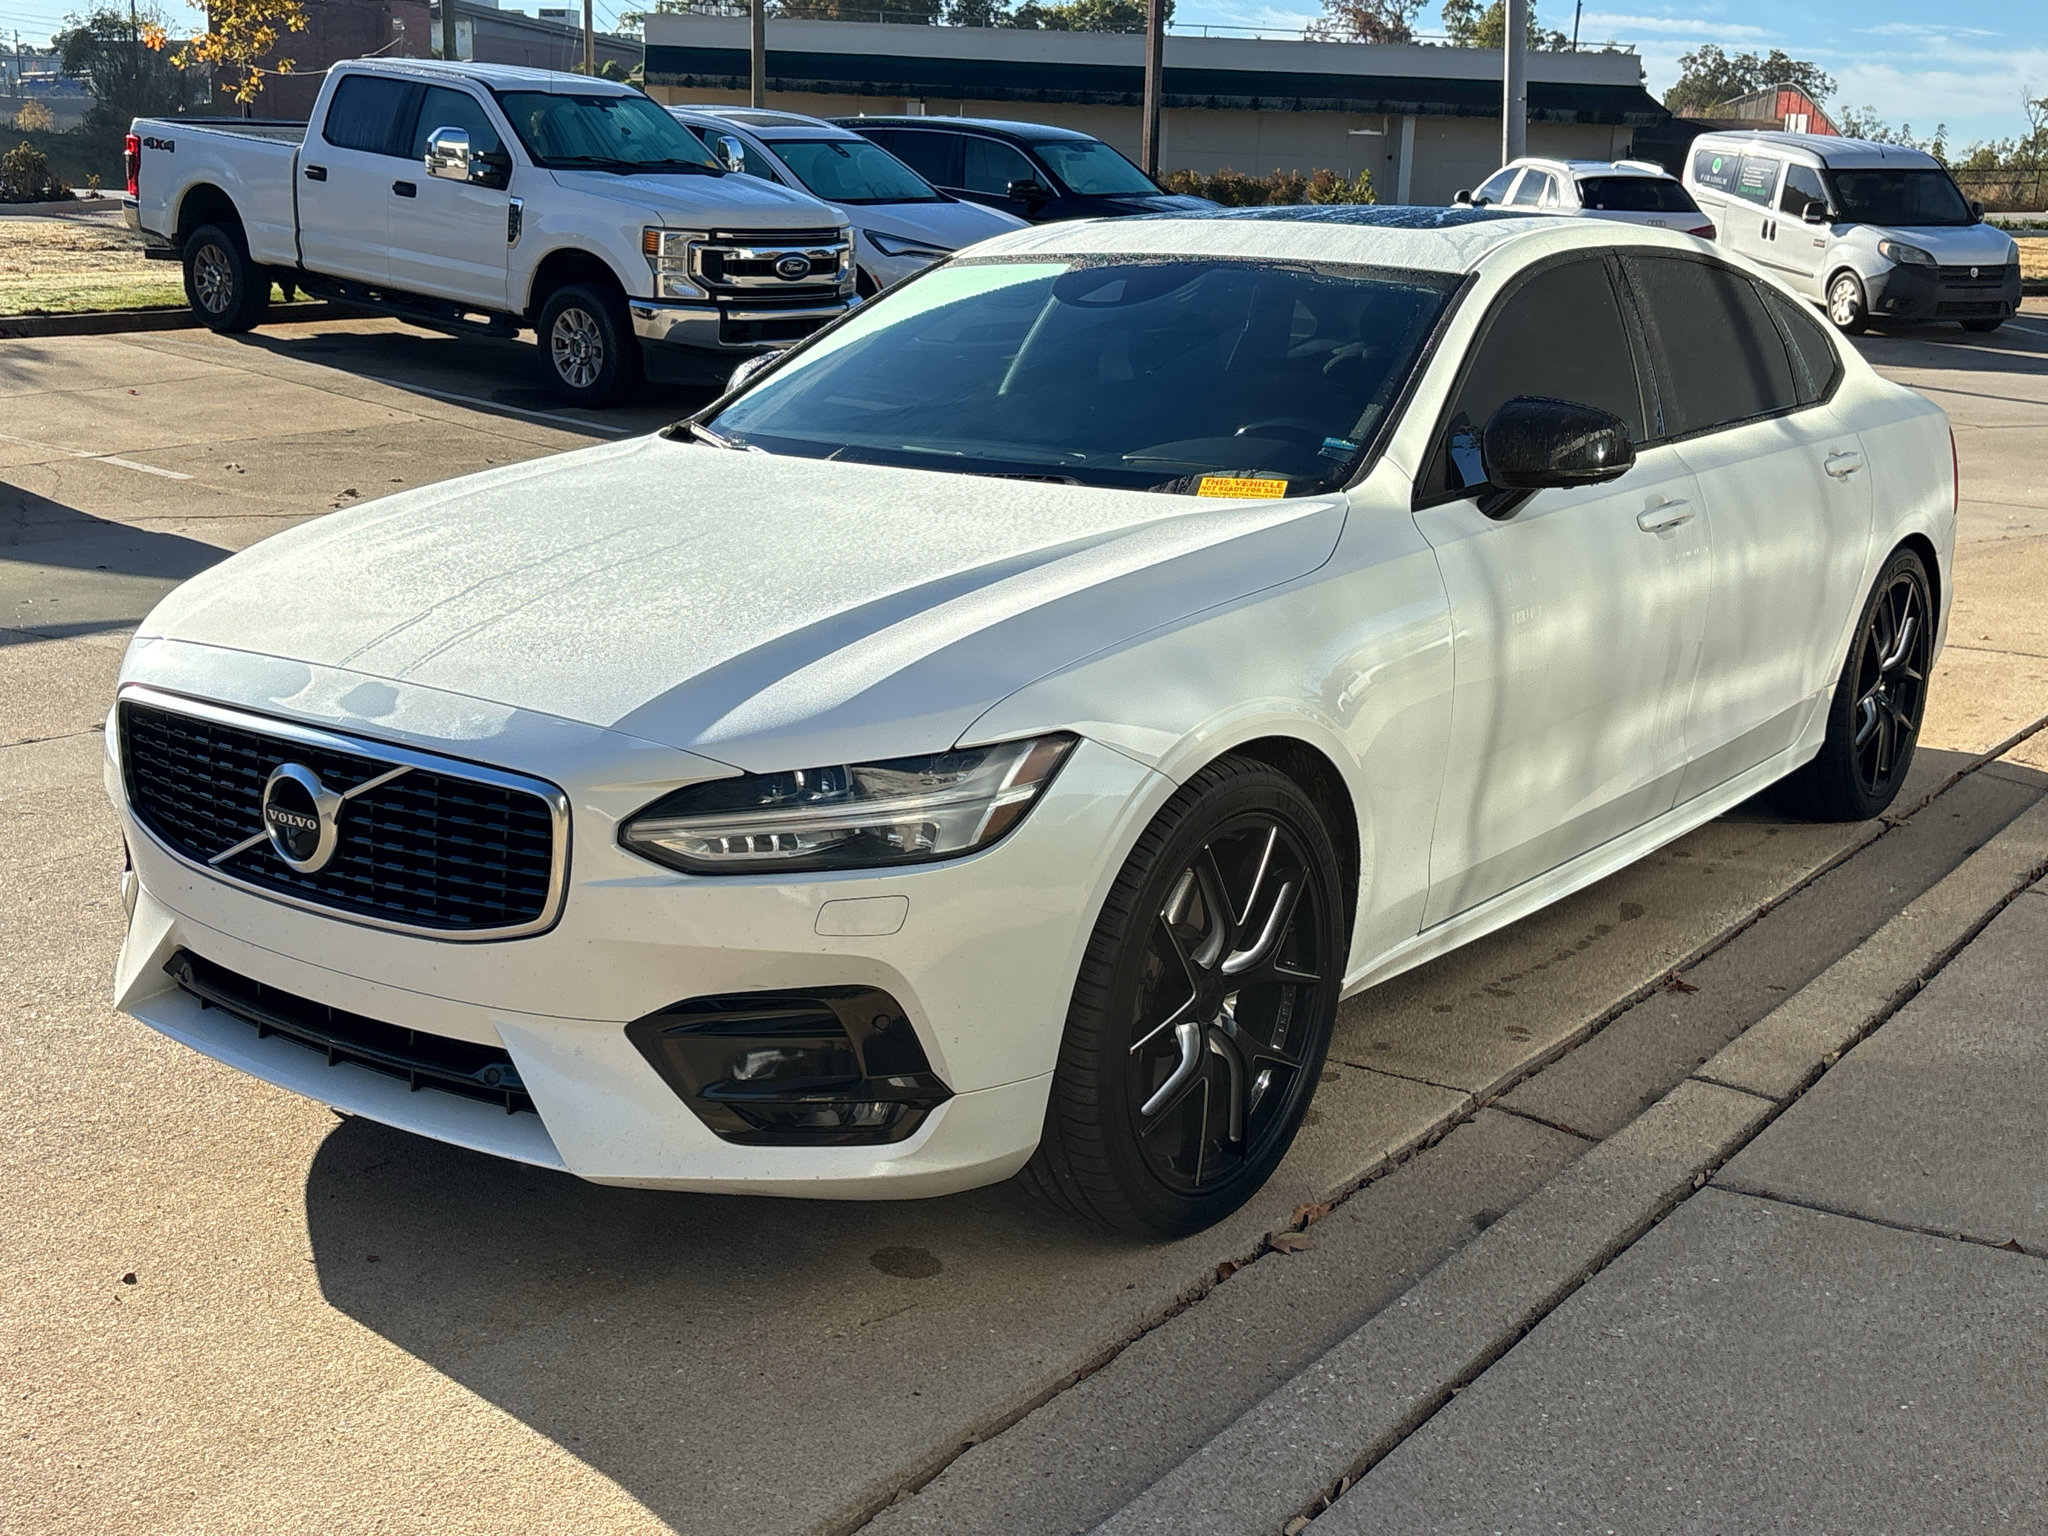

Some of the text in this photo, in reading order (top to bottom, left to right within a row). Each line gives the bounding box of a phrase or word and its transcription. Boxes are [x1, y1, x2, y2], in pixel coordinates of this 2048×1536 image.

[784, 261, 803, 272] Ford
[1235, 480, 1285, 488] VEHICLE
[268, 809, 317, 830] VOLVO
